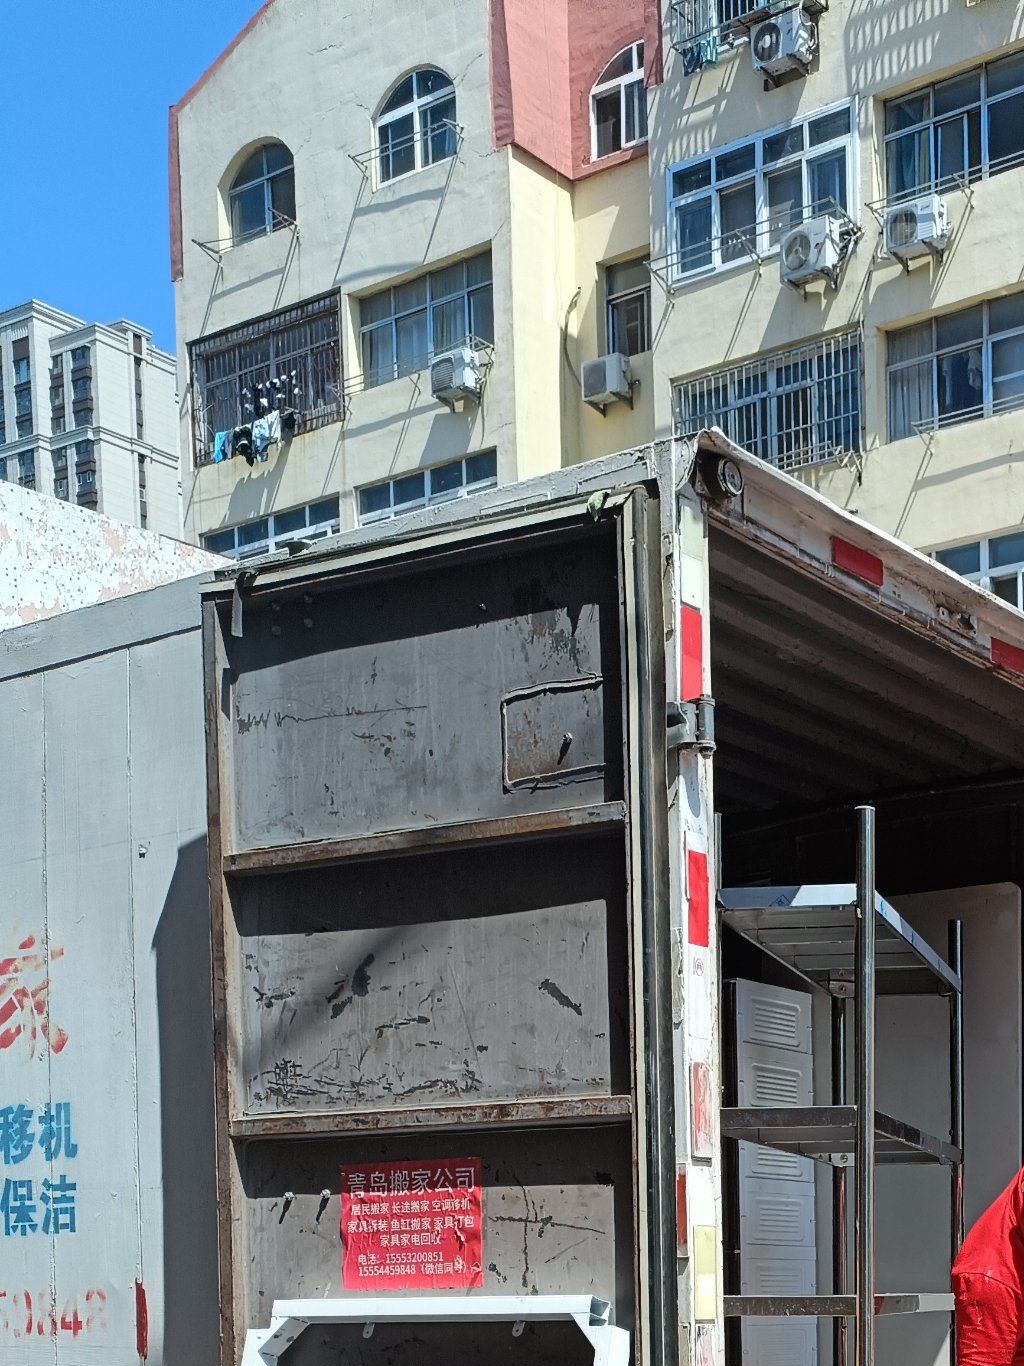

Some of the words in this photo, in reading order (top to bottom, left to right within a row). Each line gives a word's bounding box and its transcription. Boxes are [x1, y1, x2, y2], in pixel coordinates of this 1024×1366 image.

[347, 1167, 476, 1200] 青岛搬家公司
[0, 1174, 77, 1236] 保洁
[351, 1202, 389, 1216] 居民搬家
[391, 1200, 430, 1213] 长途搬家
[432, 1197, 471, 1212] 空调移机
[347, 1219, 389, 1234] 家具拆装
[390, 1217, 431, 1232] 鱼缸搬家
[379, 1232, 442, 1247] 家具家电回收
